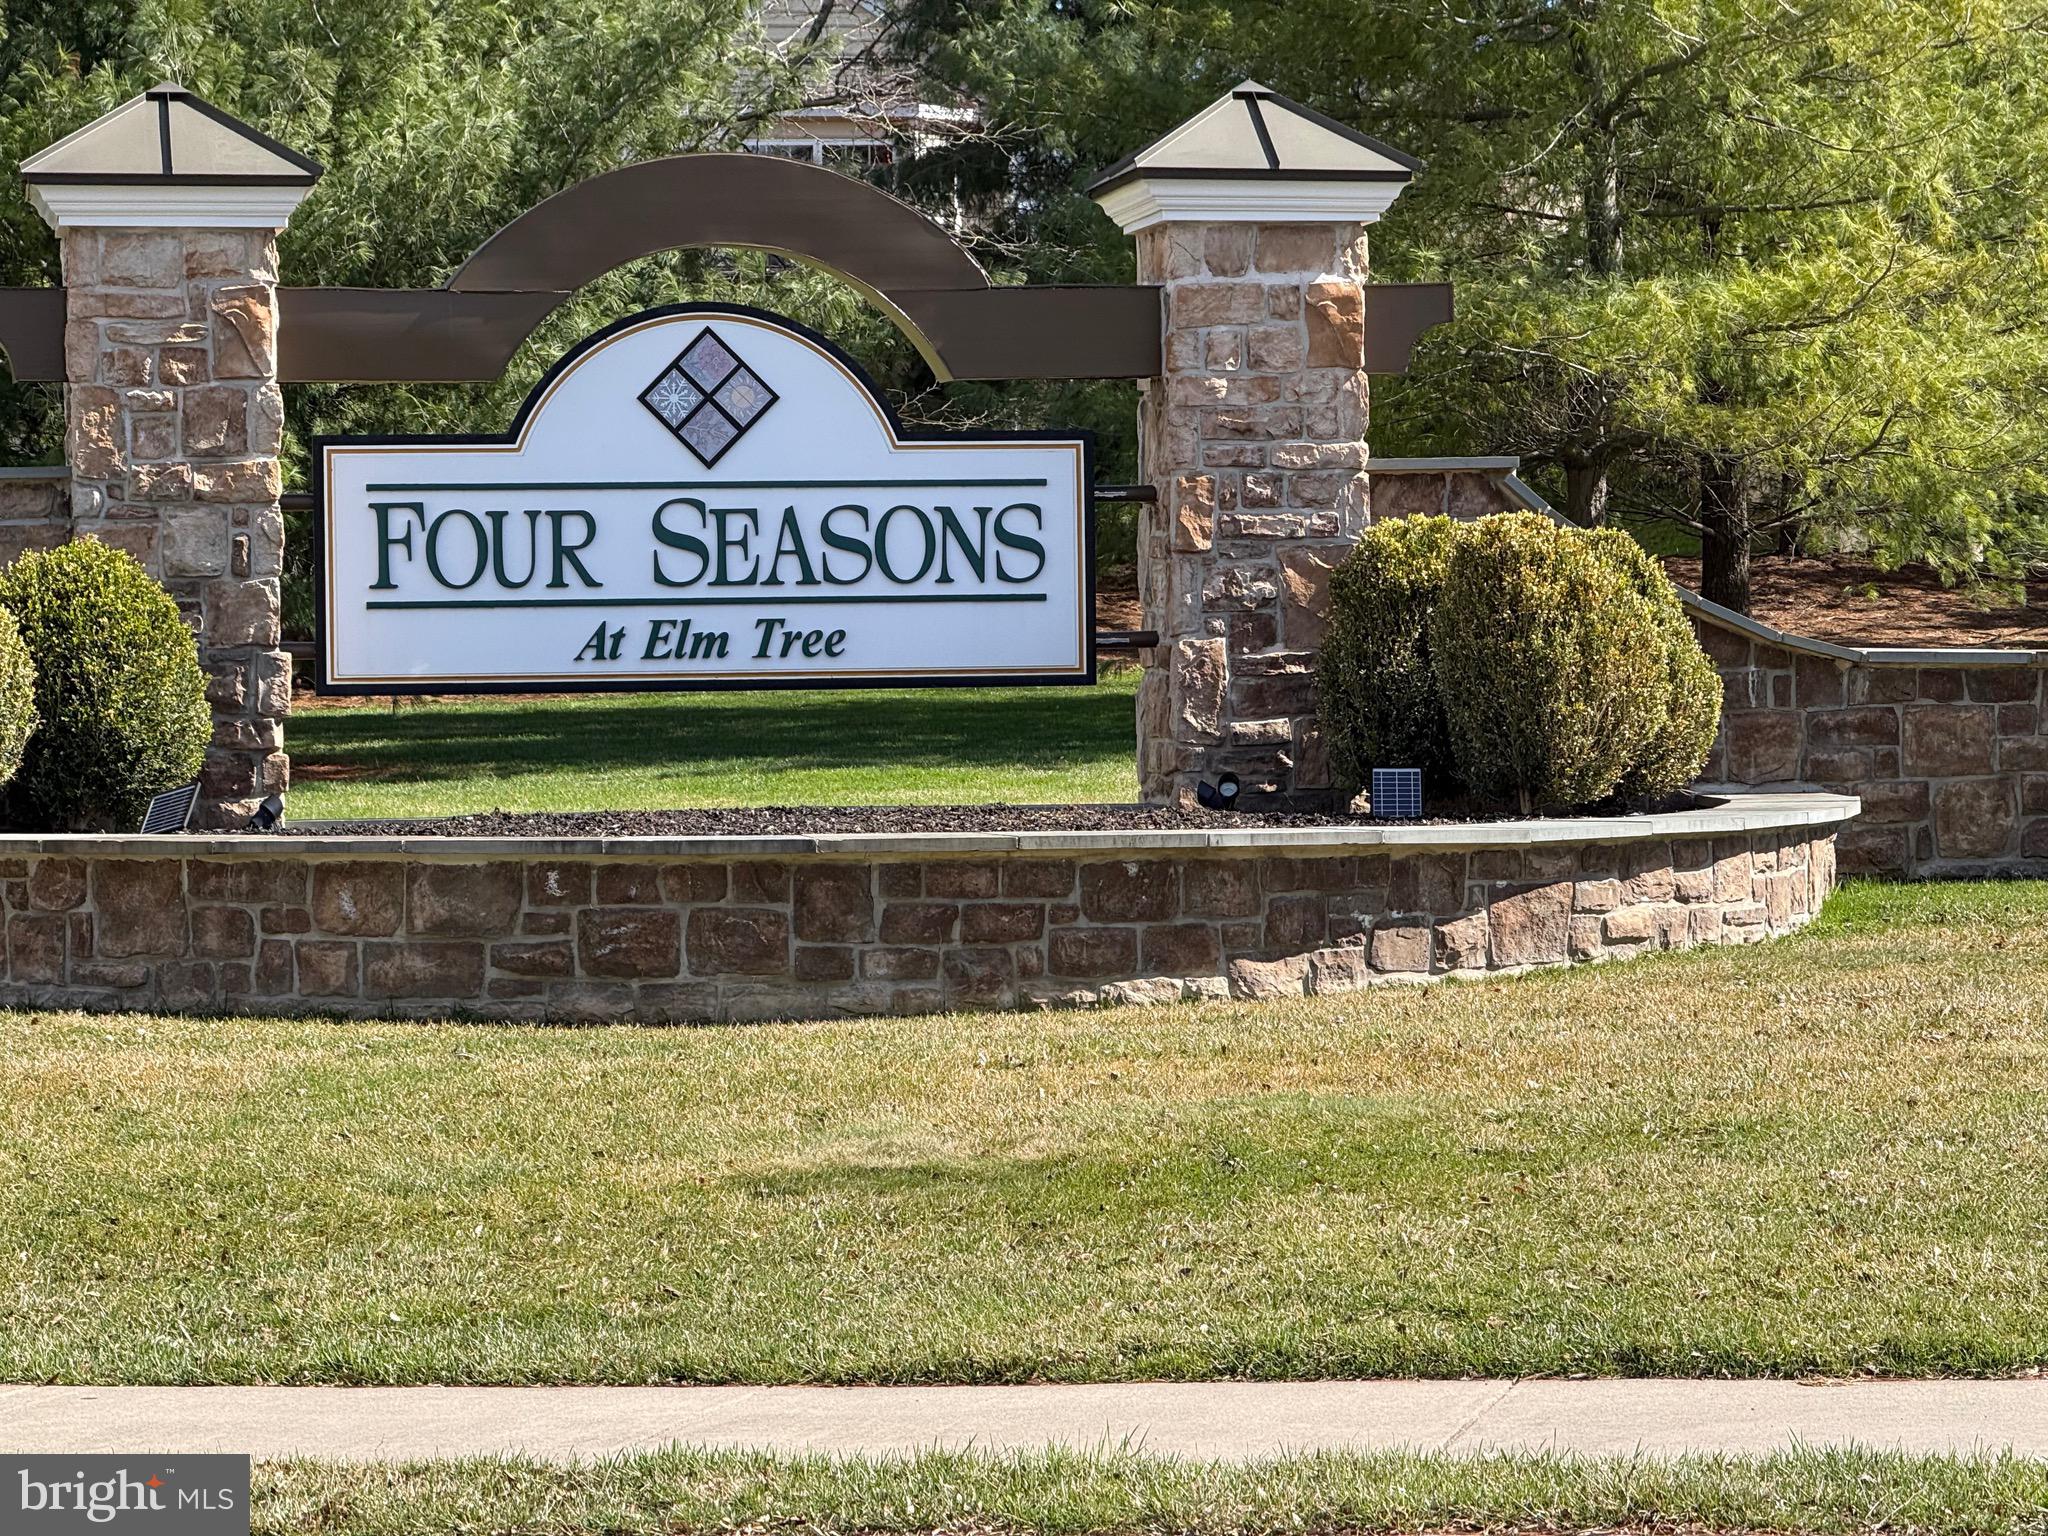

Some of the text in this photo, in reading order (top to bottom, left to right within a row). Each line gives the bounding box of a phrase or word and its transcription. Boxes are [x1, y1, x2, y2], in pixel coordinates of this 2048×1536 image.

[368, 497, 1046, 591] FOUR SEASONS
[574, 618, 847, 662] At Elm Tree
